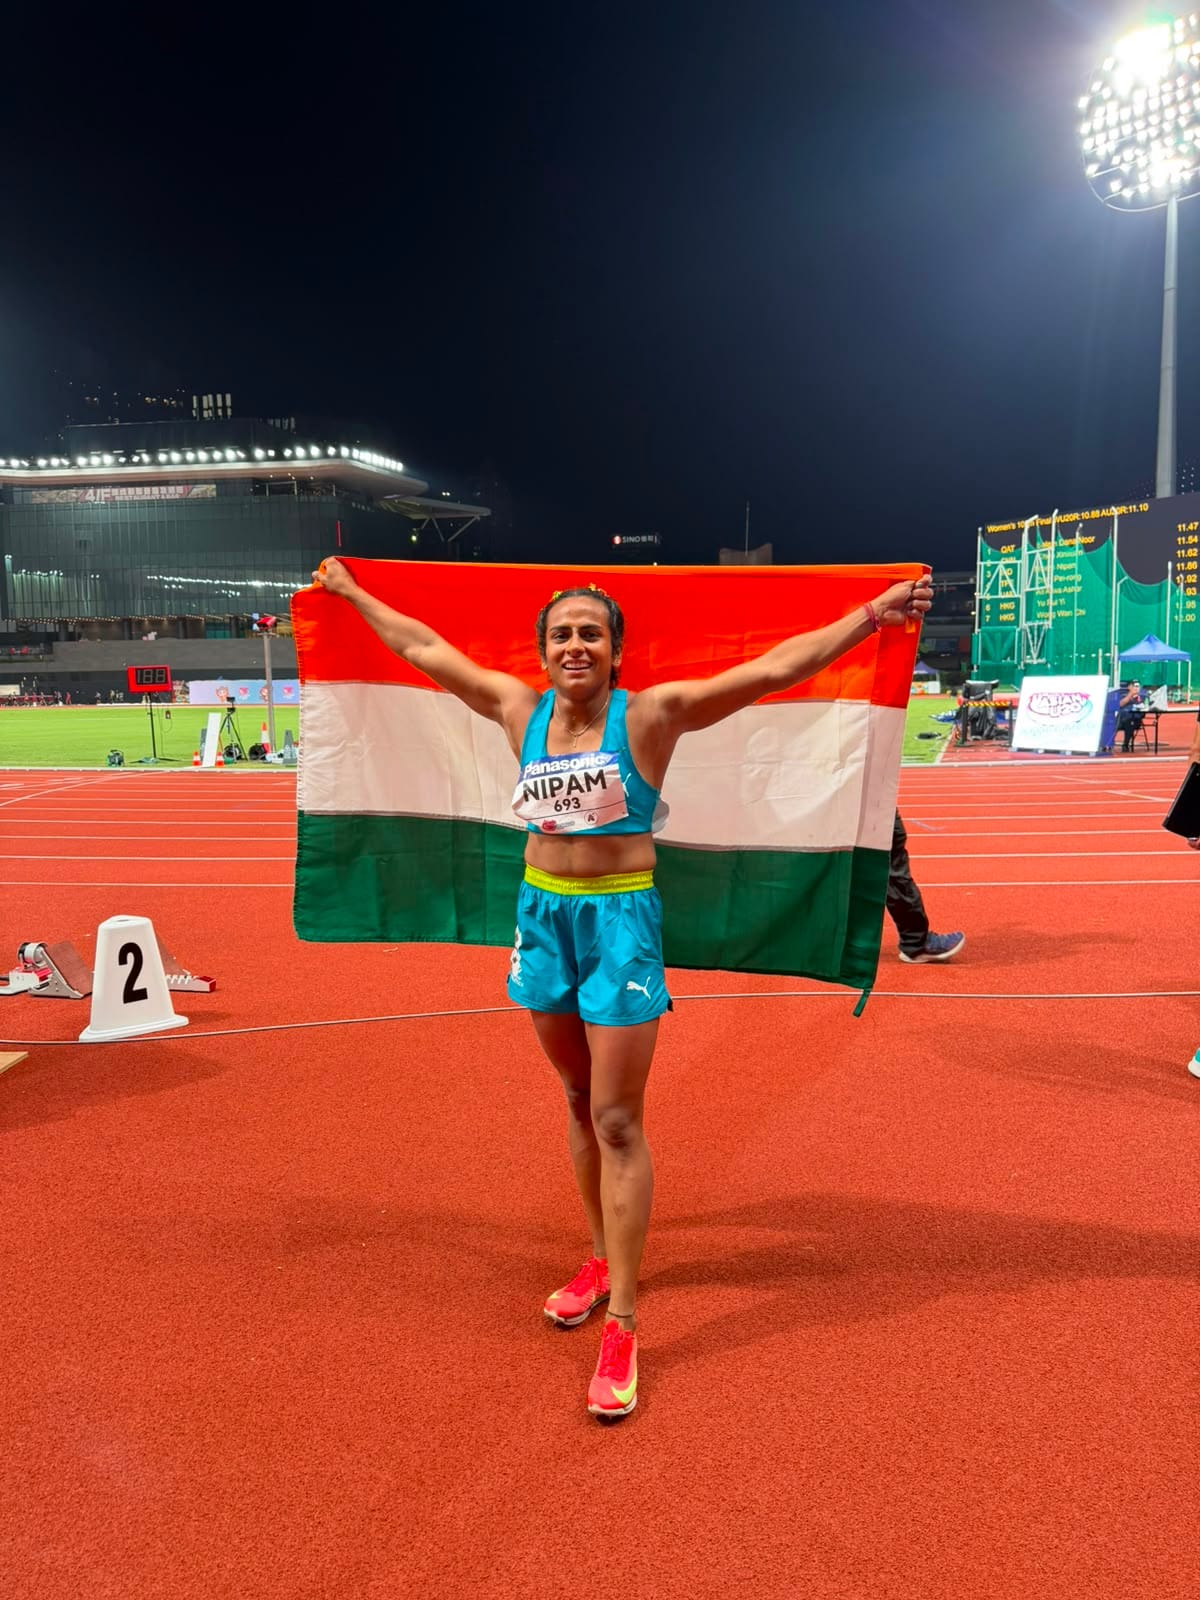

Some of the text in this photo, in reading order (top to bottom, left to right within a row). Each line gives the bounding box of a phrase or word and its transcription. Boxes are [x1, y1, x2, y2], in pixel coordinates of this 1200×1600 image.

[986, 523, 1016, 534] Women's
[1018, 520, 1035, 529] 10m
[1000, 545, 1016, 554] QAT
[1177, 521, 1199, 532] 11.47
[1176, 548, 1198, 558] 11.62
[523, 755, 606, 778] Panasonic
[523, 769, 607, 802] NIPAM
[554, 797, 582, 812] 693
[118, 942, 149, 1004] 2
